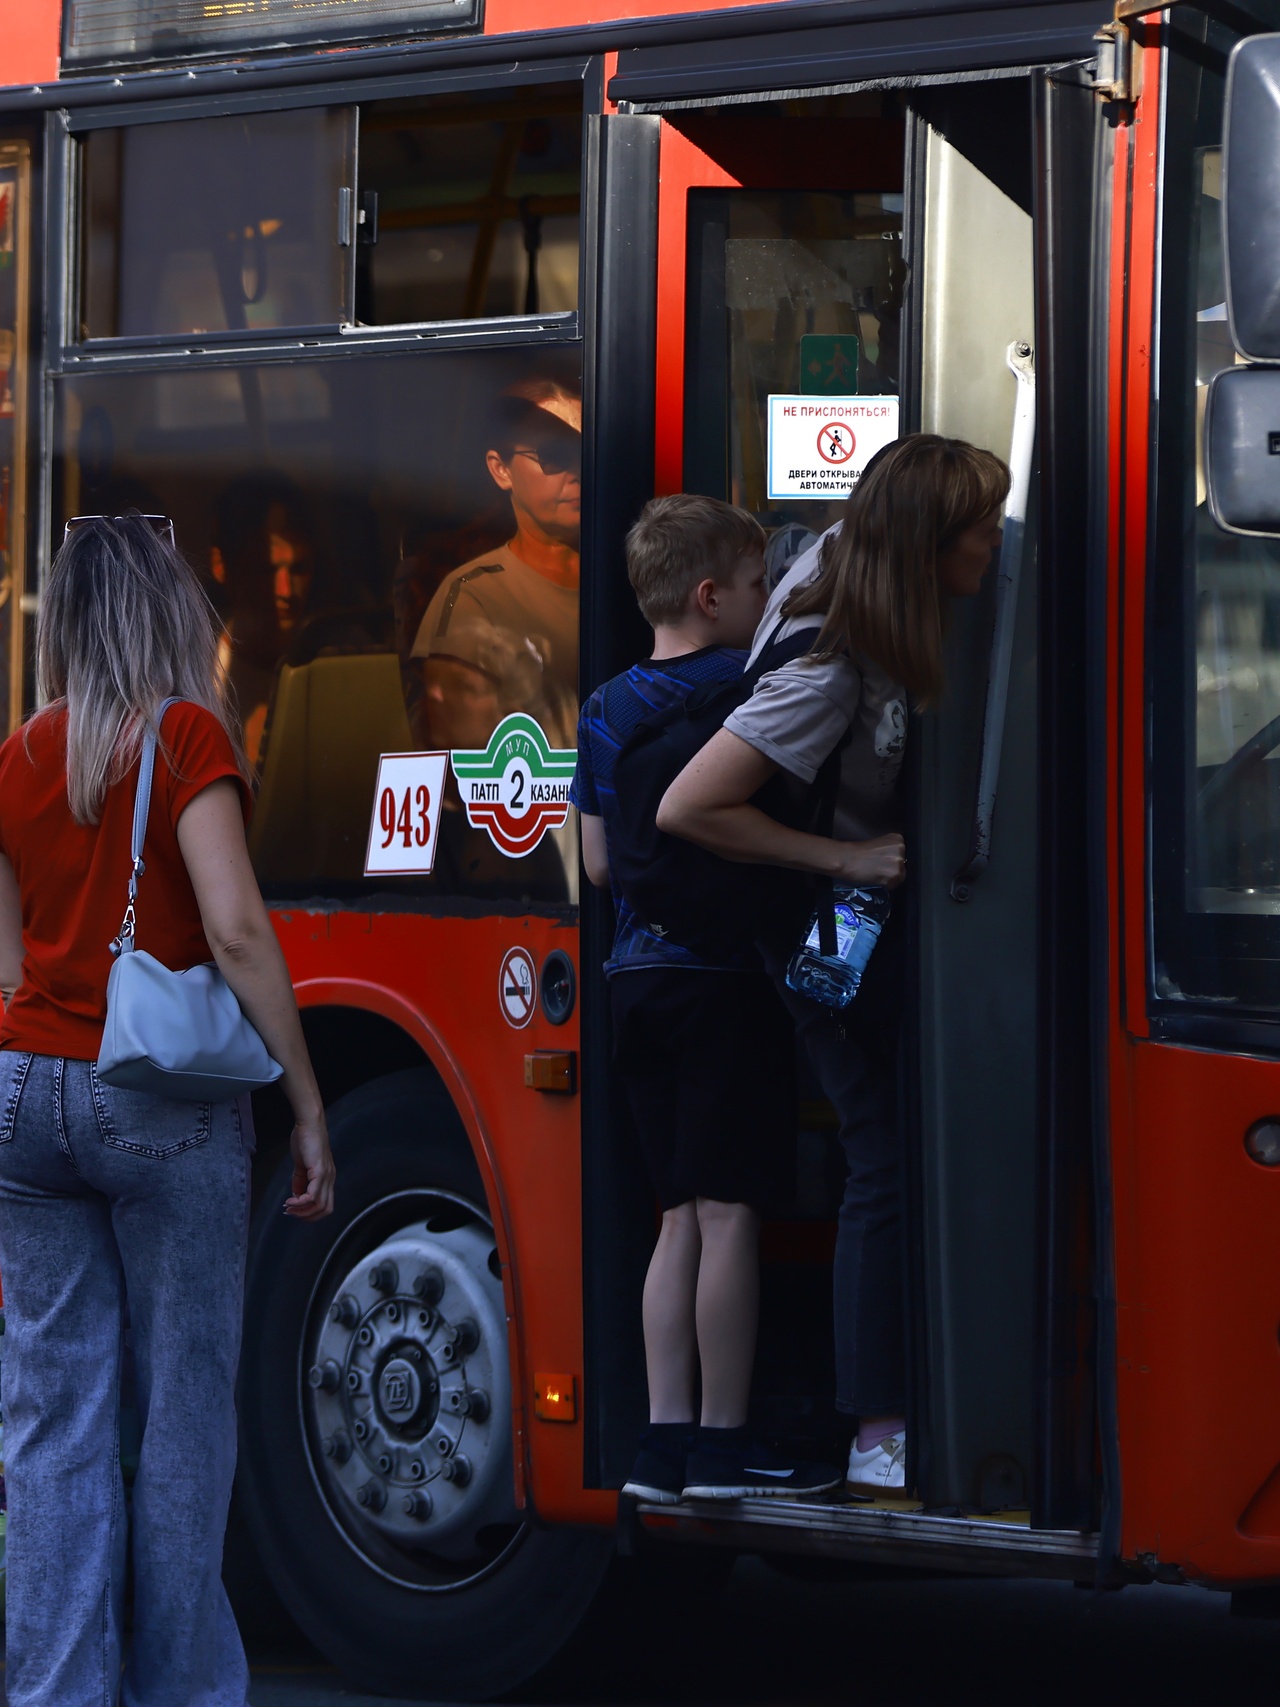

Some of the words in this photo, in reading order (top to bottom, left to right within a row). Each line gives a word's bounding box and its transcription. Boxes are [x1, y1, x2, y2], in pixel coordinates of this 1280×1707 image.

[783, 406, 797, 417] НЕ
[800, 406, 890, 417] ПРИСЛОНЯТЬСЯ!
[788, 469, 817, 480] ДВЕРИ
[819, 469, 865, 479] ОТКРЫВА
[471, 783, 500, 801] ПАТП
[510, 770, 525, 809] 2
[380, 785, 431, 849] 943
